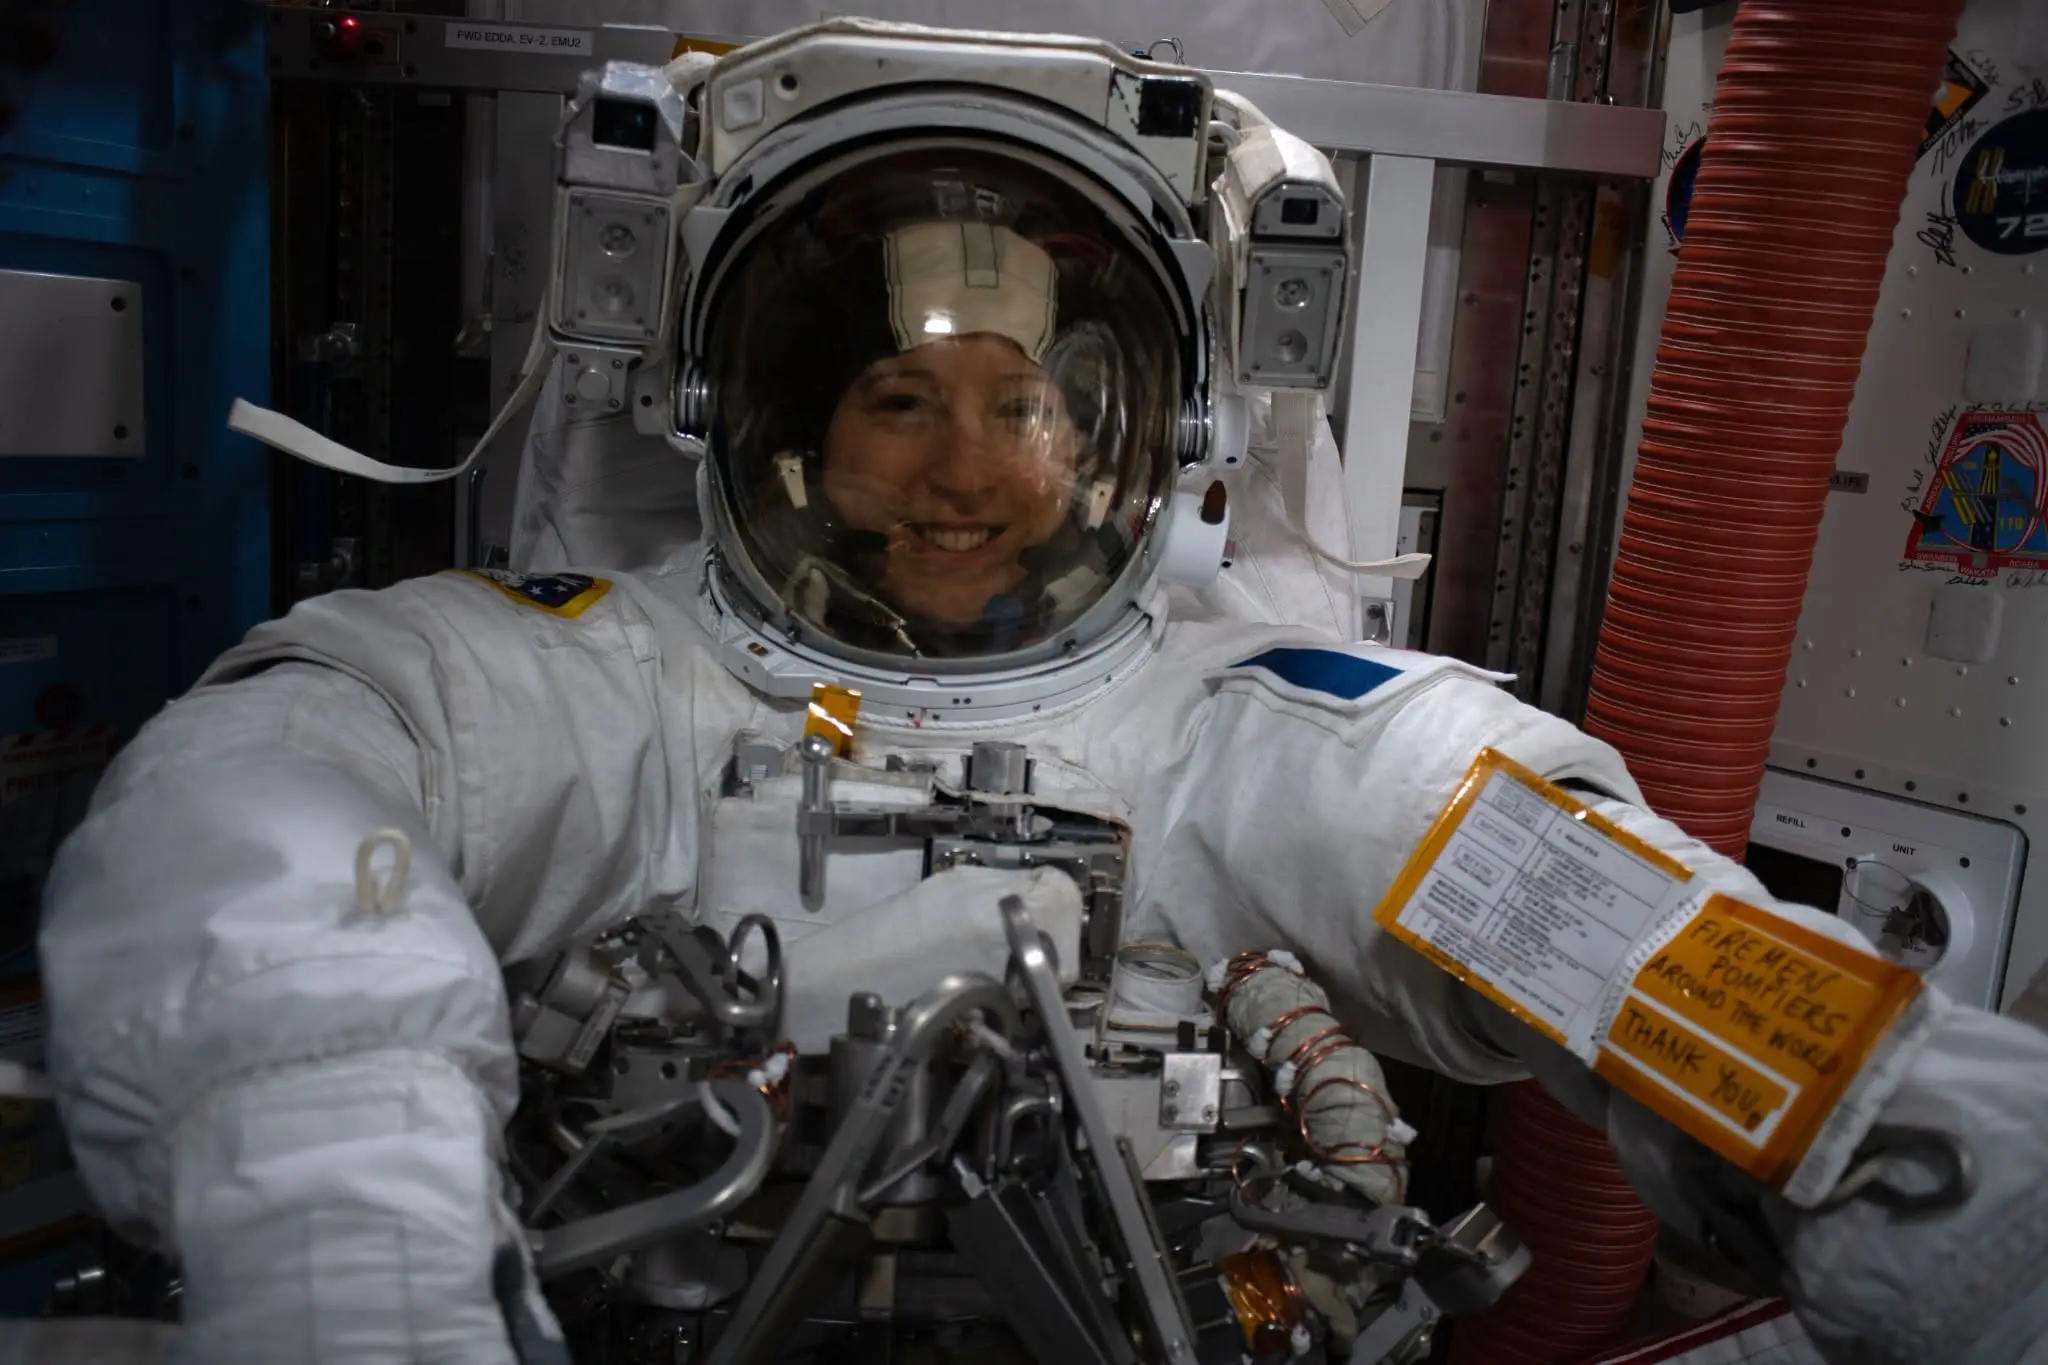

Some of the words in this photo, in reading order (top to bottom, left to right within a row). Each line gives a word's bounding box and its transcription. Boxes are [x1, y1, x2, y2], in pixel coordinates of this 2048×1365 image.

[457, 30, 482, 41] FWD
[519, 34, 549, 47] EV-2,
[551, 36, 582, 48] EMU2
[1996, 213, 2048, 240] 72
[1915, 552, 1959, 562] SWANSON
[1960, 566, 1997, 577] WAKATA
[1776, 812, 1806, 829] REFILL
[1892, 842, 1917, 857] UNIT
[1640, 954, 1728, 1012] AROUND
[1729, 998, 1768, 1034] THE
[1768, 1026, 1843, 1076] WORLD
[1622, 1006, 1709, 1075] THANK
